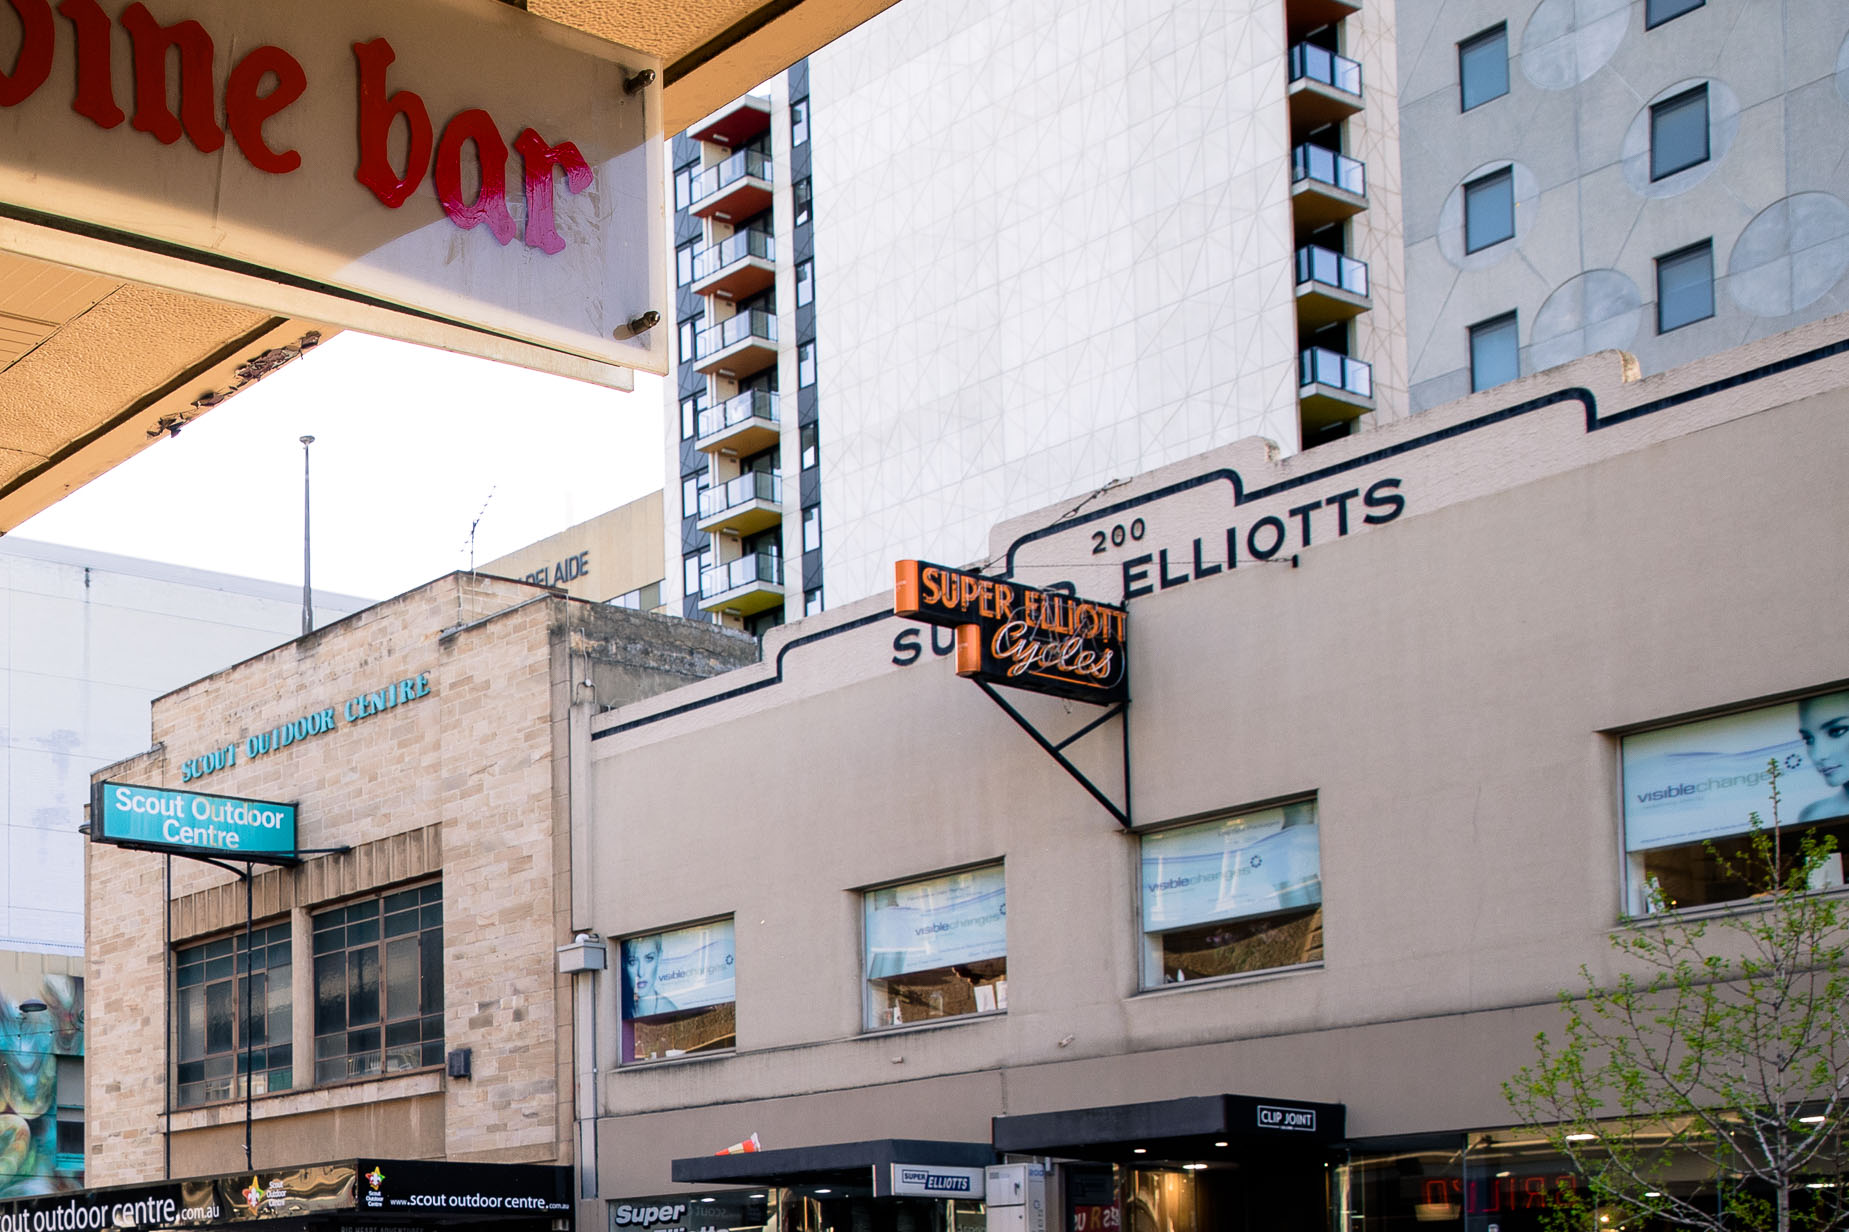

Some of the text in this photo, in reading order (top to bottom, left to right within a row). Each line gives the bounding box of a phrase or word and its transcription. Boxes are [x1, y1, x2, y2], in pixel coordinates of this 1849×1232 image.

[353, 37, 592, 254] bar
[1092, 518, 1145, 555] 200
[1122, 477, 1406, 601] ELLIOTTS
[518, 550, 589, 587] DELAIDE
[922, 566, 1014, 620] SUPER
[992, 620, 1114, 678] Cycles
[182, 670, 432, 783] SCOUT OUTDOOR CENTRE
[115, 788, 284, 829] Scout Outdoor
[163, 819, 240, 849] Centre
[1261, 1110, 1312, 1126] CLIP JOINT
[904, 1172, 969, 1190] SUPER ELLIOTTS
[33, 1200, 108, 1232] outdoor
[449, 1194, 503, 1208] outdoor
[615, 1204, 686, 1226] Super
